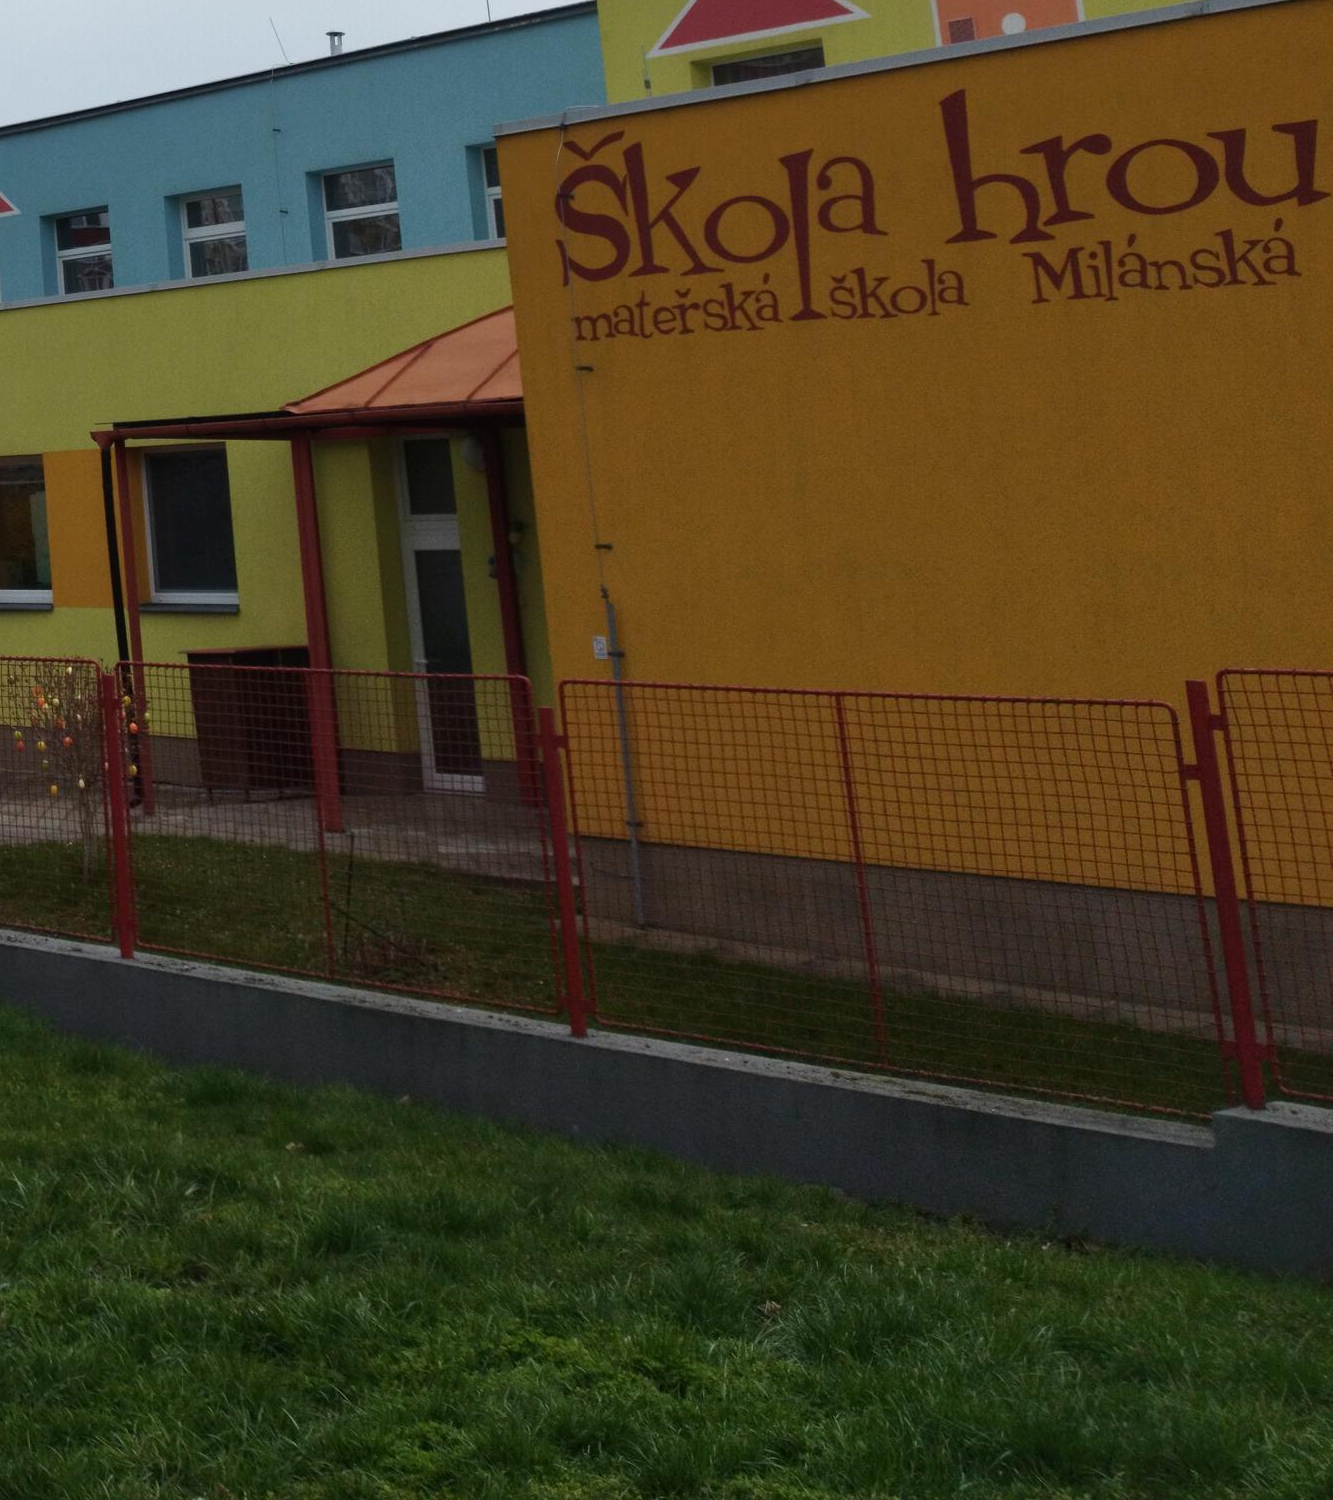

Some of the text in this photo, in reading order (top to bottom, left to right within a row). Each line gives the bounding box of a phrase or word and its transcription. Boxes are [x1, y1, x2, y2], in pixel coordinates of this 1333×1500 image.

[555, 89, 1332, 321] Škola hrou
[572, 218, 1302, 342] mateřská škola Milánská
